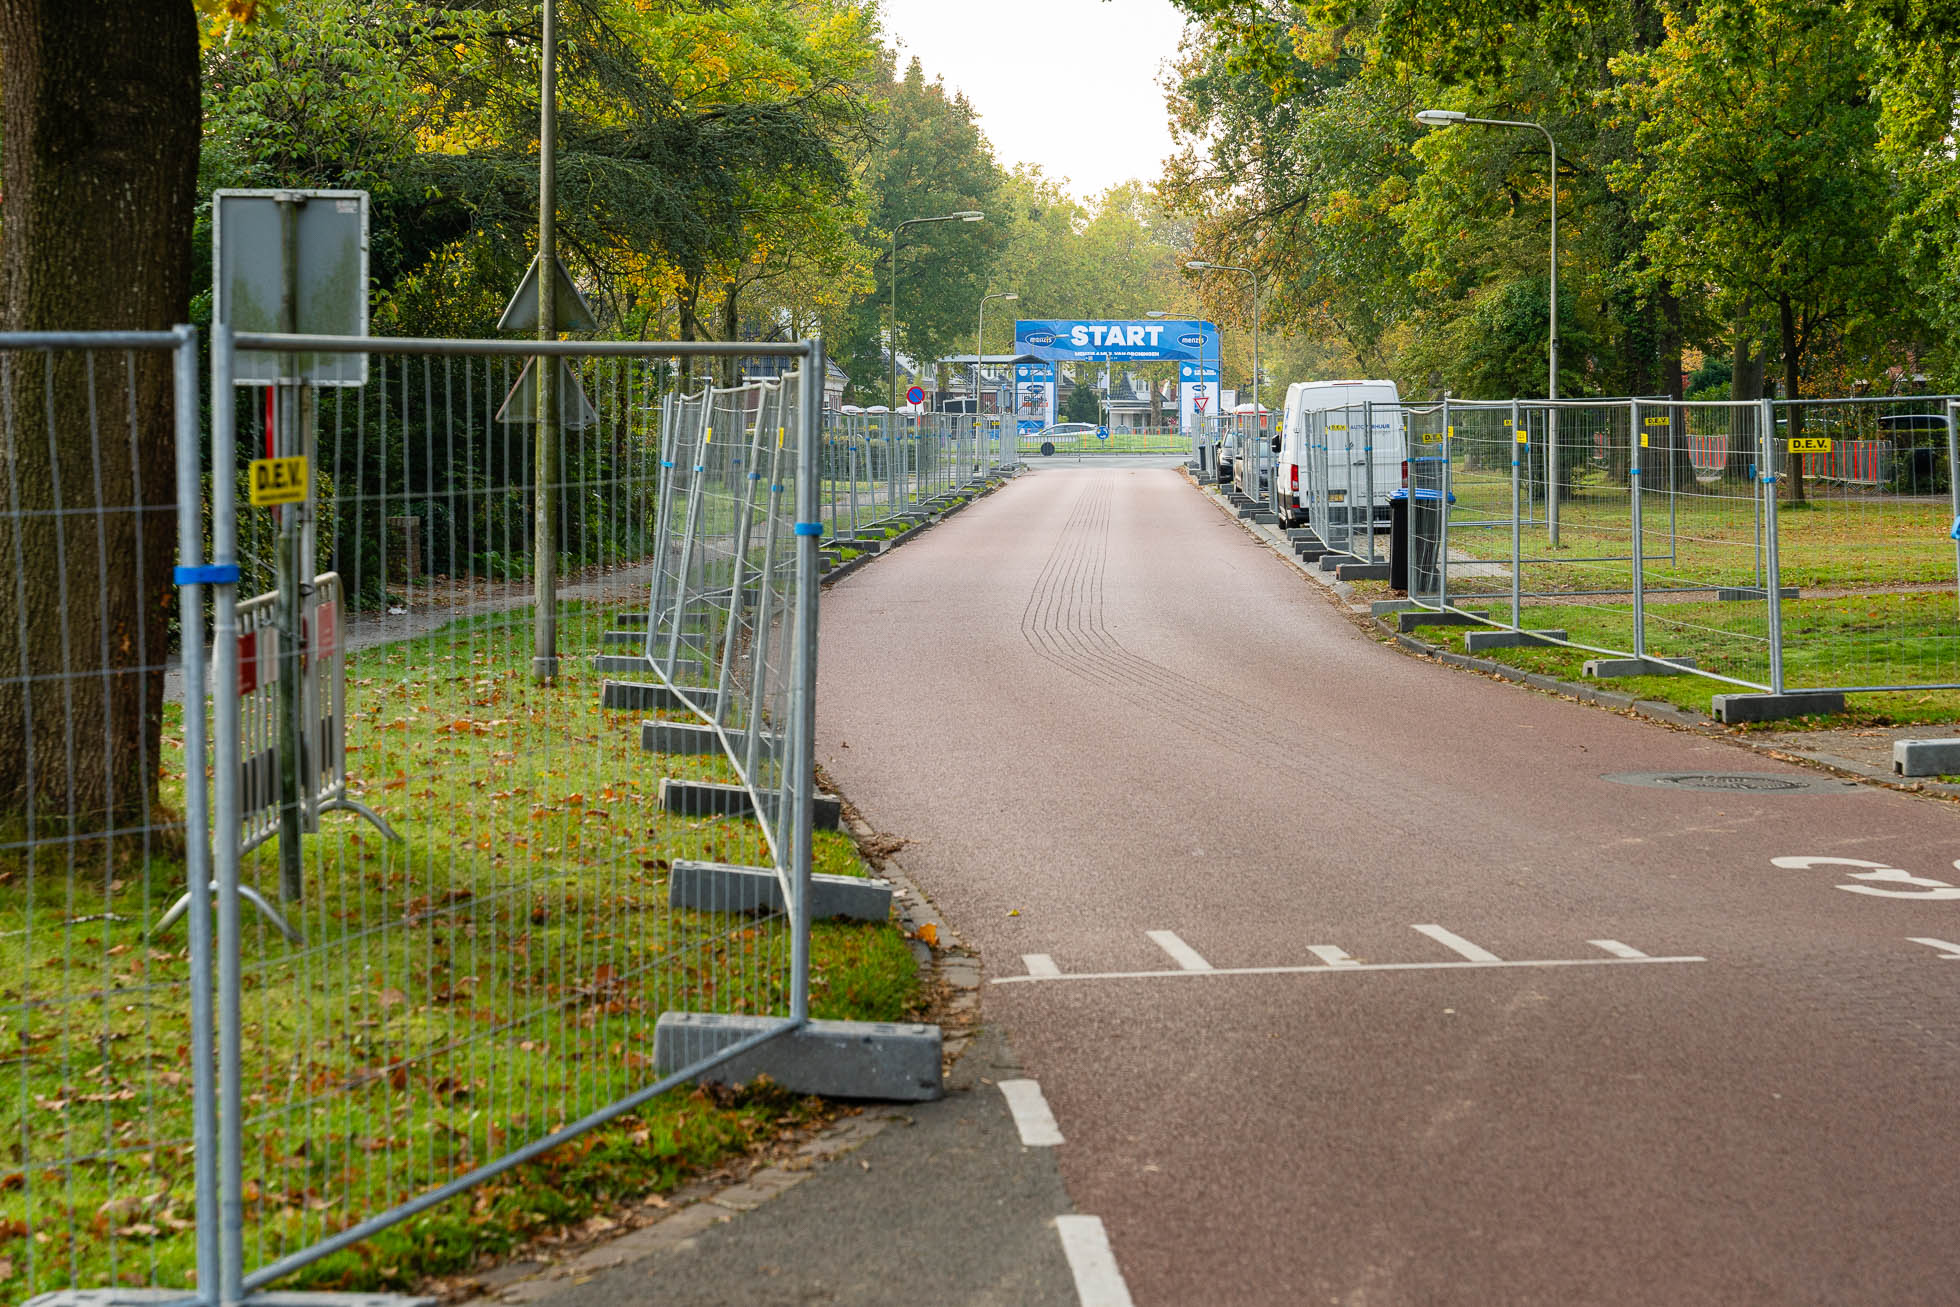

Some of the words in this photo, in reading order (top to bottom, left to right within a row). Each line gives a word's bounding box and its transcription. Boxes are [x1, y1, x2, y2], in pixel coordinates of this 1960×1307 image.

[1071, 325, 1164, 346] START
[1793, 439, 1827, 448] D.E.V.
[257, 460, 303, 490] D.E.V.
[1770, 856, 1960, 900] 3
